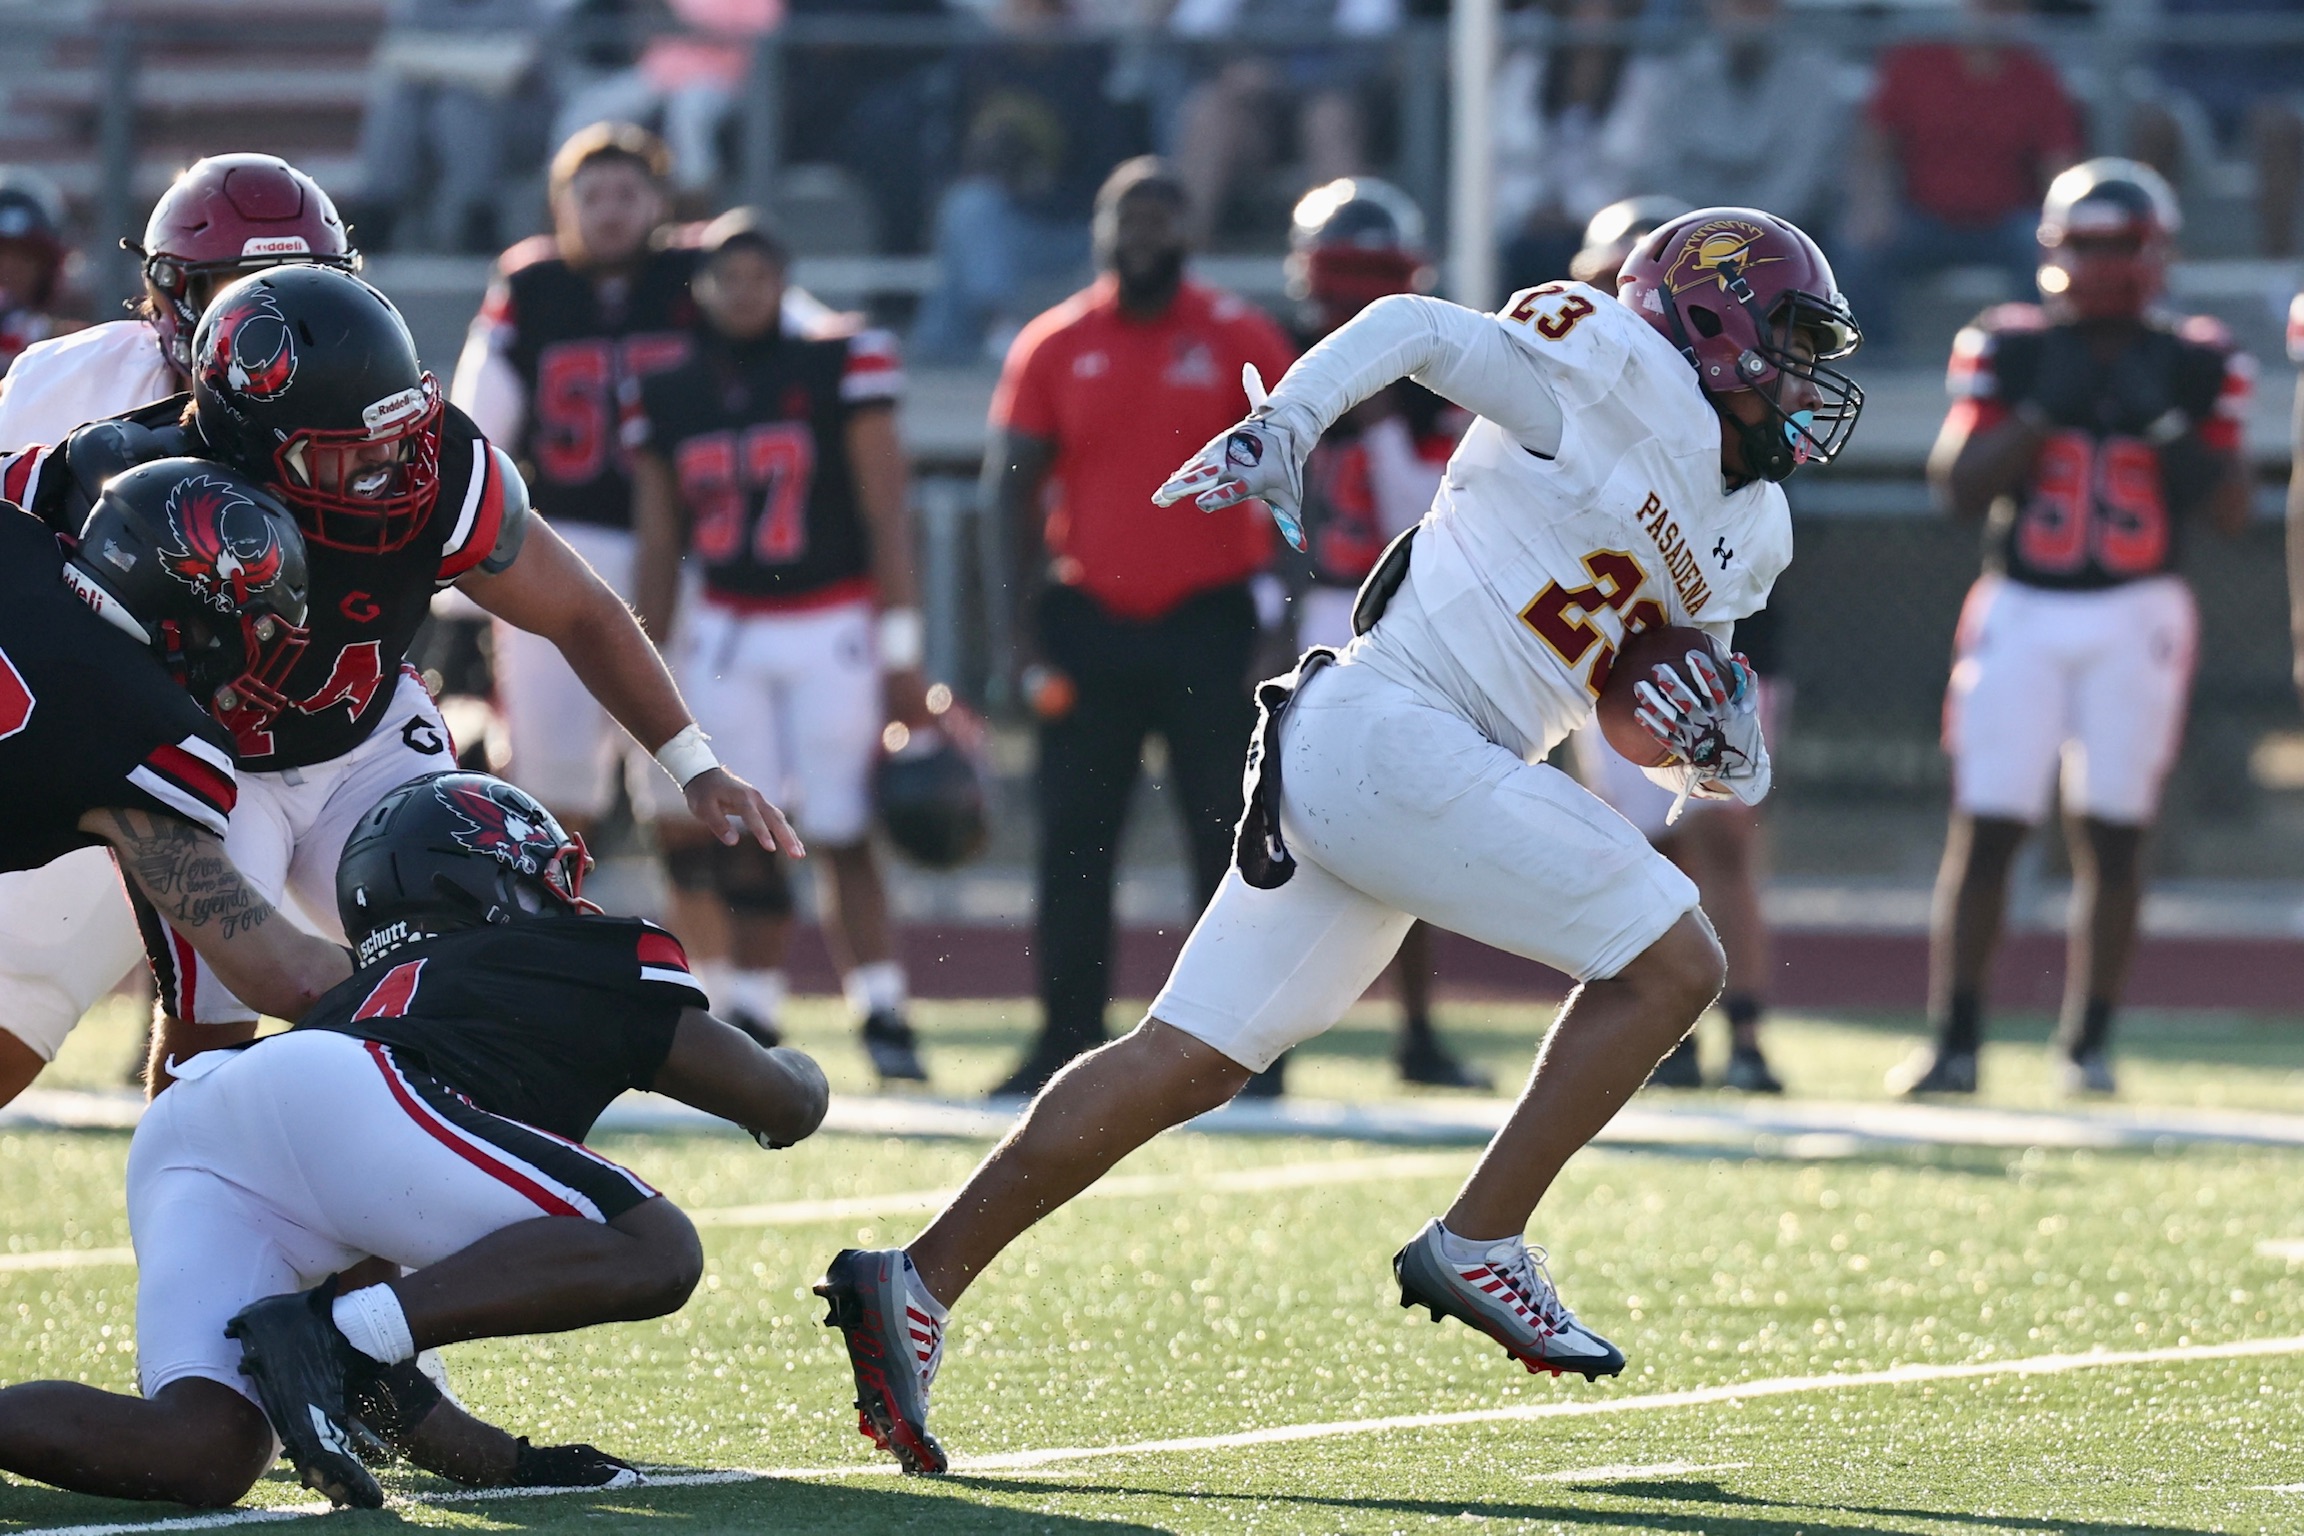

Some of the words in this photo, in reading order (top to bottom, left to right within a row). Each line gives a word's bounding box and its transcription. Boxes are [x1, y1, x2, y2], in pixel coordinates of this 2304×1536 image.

[1508, 284, 1598, 342] 23
[378, 394, 411, 416] Riddell
[1635, 490, 1713, 619] PASADENA
[339, 590, 382, 624] G
[400, 714, 445, 756] G
[356, 887, 368, 908] 4
[360, 920, 408, 960] schutt
